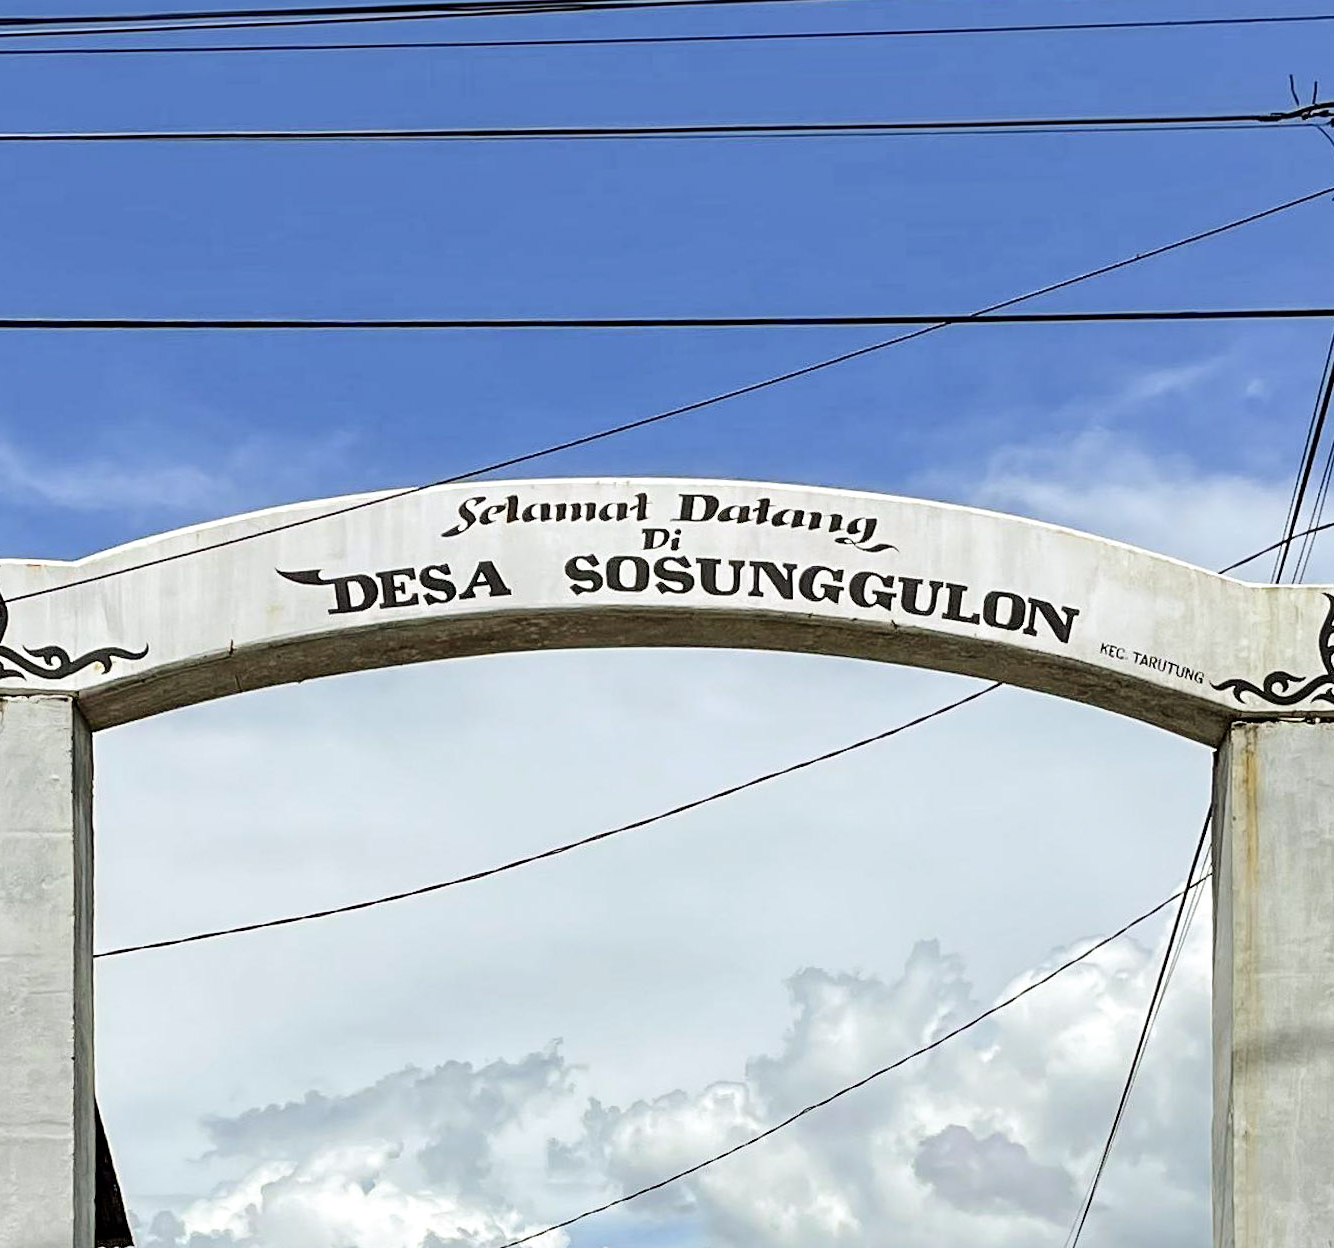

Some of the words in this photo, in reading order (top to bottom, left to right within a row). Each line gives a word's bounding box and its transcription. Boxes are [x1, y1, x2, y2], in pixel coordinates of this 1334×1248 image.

[441, 492, 650, 537] Selamat
[672, 493, 900, 552] Datang
[642, 528, 683, 552] Di
[275, 560, 512, 615] DESA
[564, 553, 1080, 643] SOSUNGGULON
[1133, 651, 1204, 684] TARUTUNG
